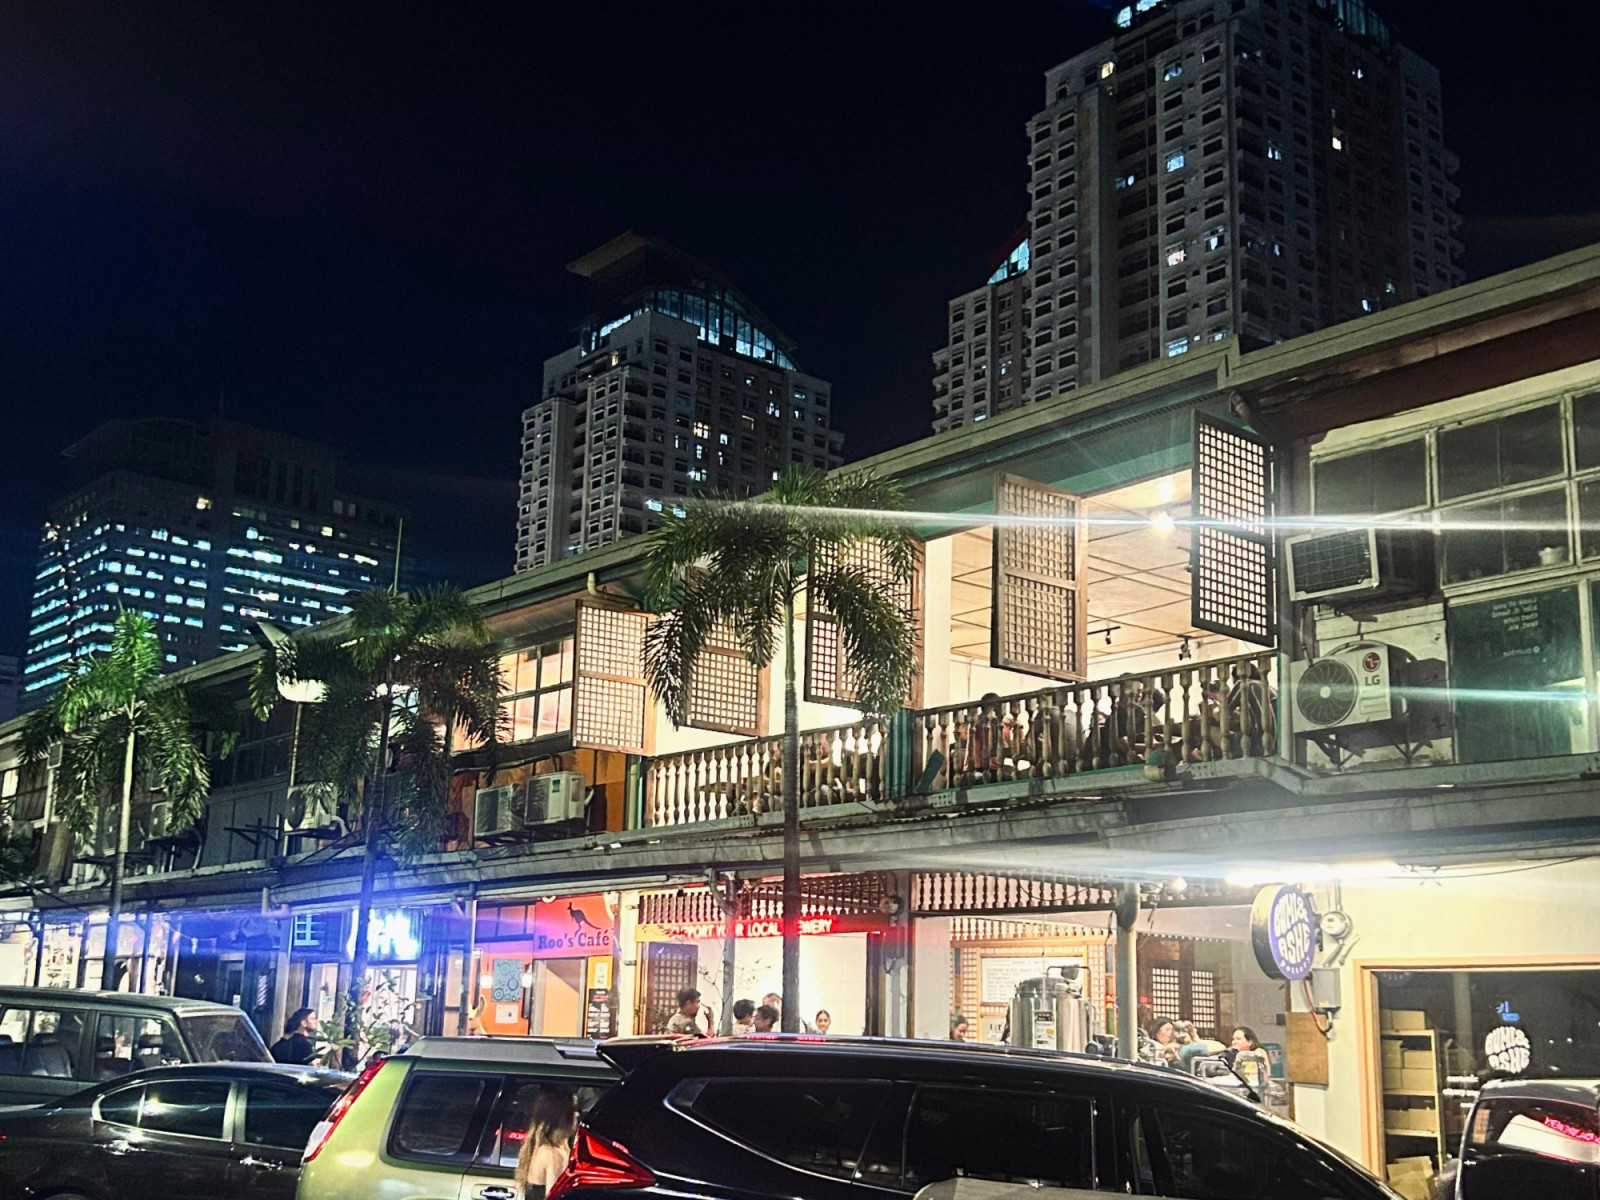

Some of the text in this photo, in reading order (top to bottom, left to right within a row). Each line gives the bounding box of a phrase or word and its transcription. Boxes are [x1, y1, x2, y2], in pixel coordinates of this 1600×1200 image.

[1365, 674, 1380, 686] LG
[747, 921, 782, 937] LOCAL
[537, 929, 610, 950] Roo's Café
